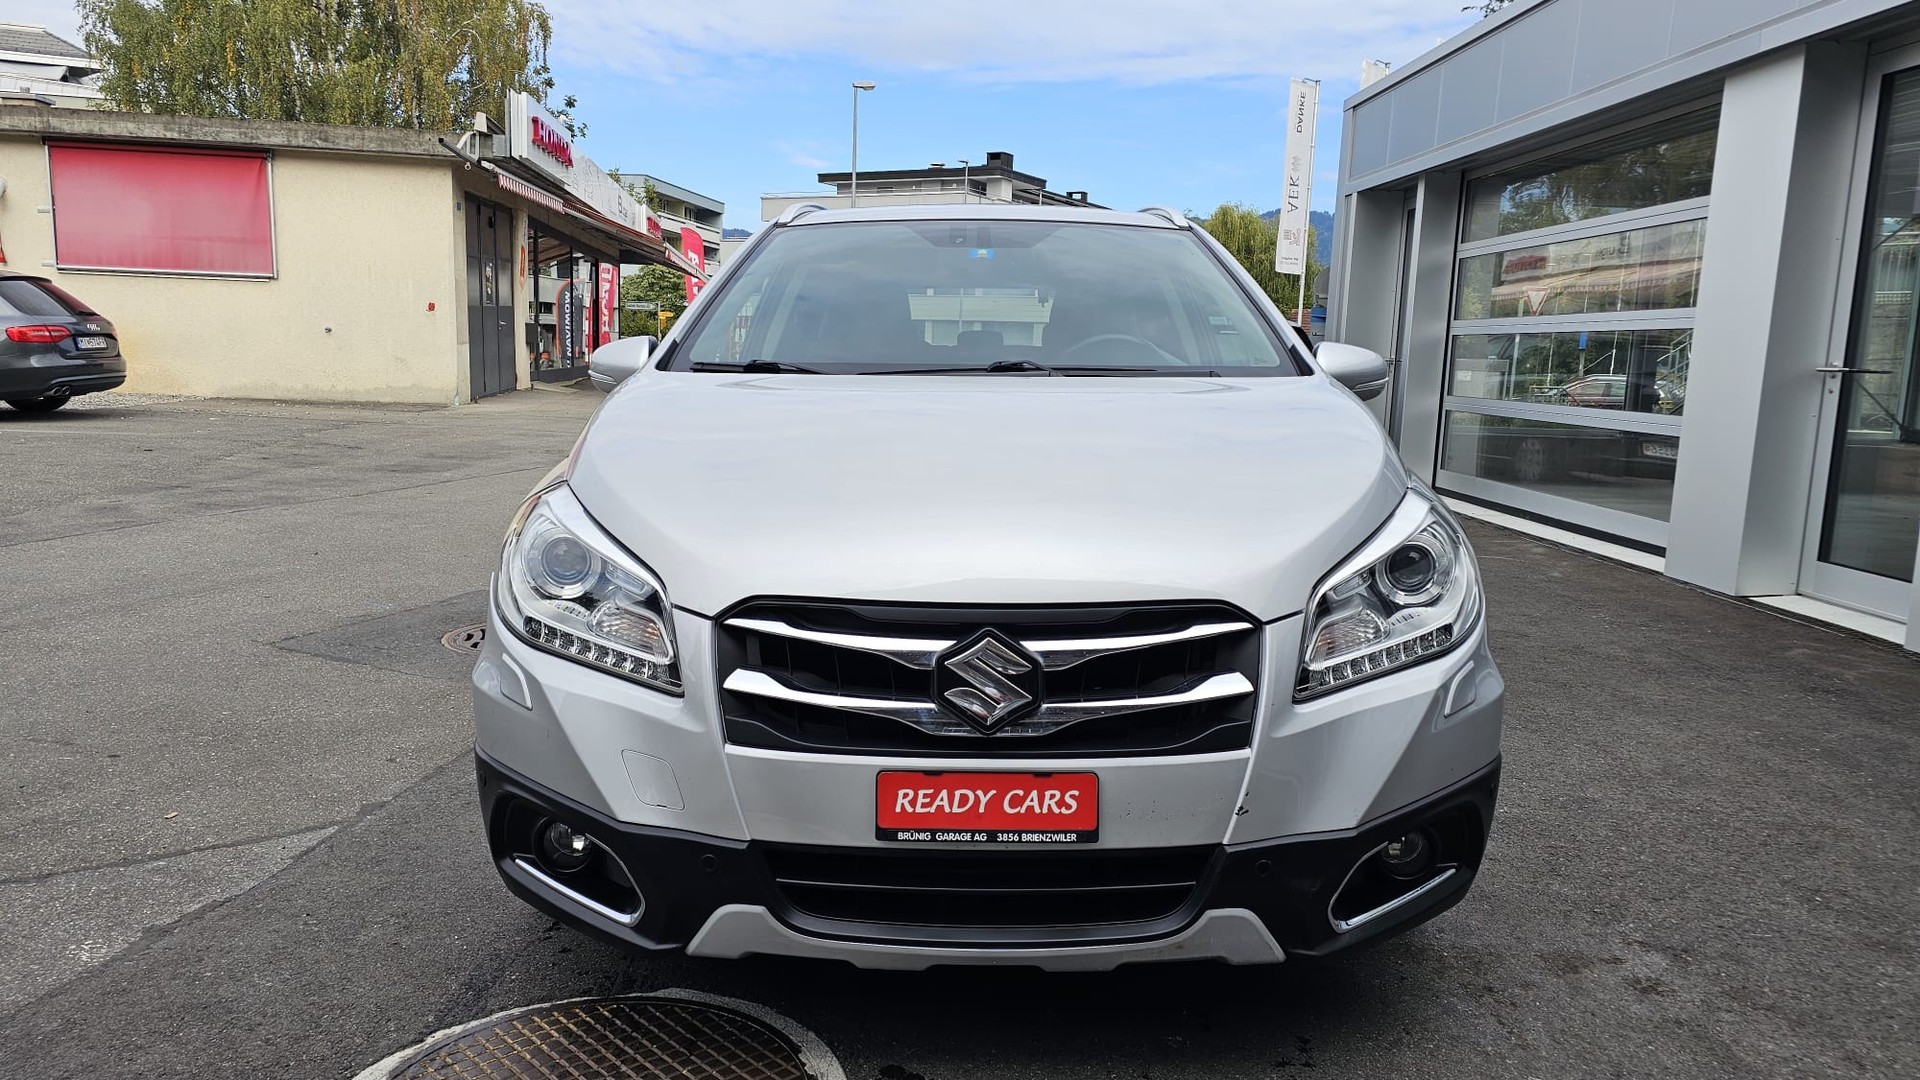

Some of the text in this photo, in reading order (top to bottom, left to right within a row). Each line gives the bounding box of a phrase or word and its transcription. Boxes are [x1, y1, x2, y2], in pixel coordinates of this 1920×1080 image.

[564, 291, 572, 357] NAVIMOW
[895, 789, 1080, 814] READY CARS
[898, 831, 1077, 842] BRÜNIG GARAGE AG 3856 BRIENZWILER
